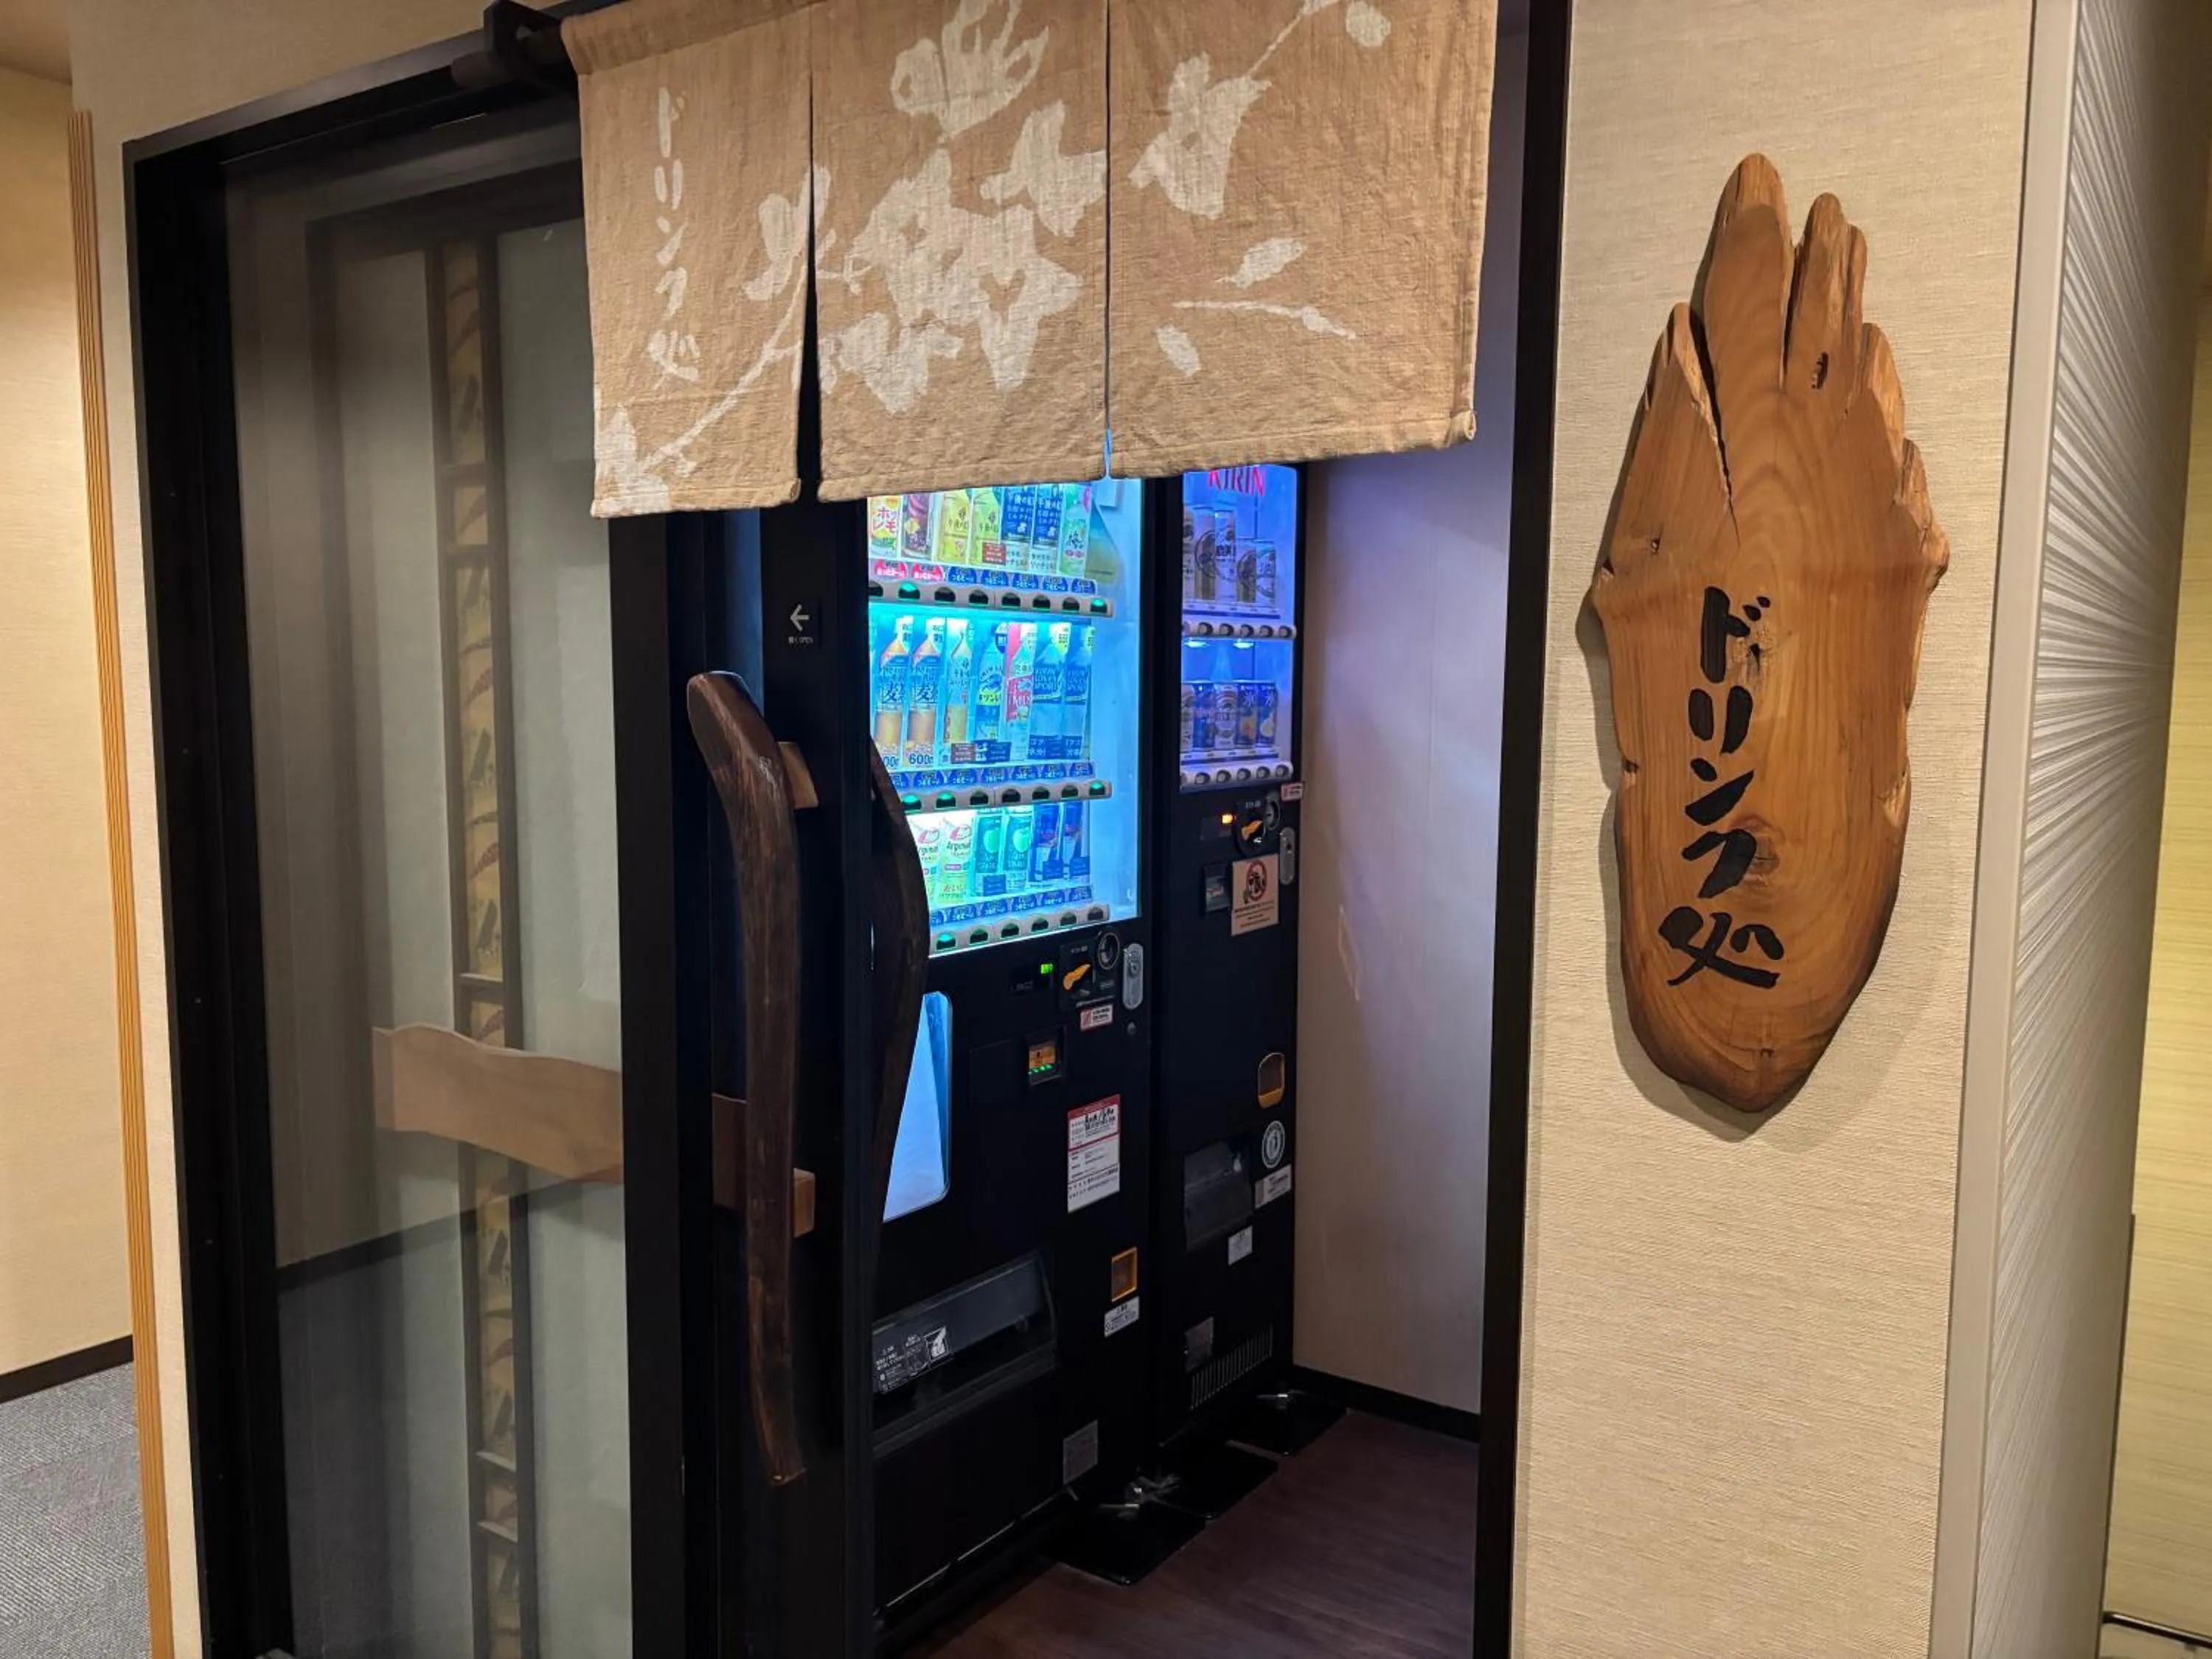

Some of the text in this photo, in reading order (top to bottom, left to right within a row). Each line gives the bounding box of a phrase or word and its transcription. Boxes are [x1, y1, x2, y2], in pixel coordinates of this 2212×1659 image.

[647, 86, 700, 390] ドリンク処
[1208, 467, 1266, 495] KIRIN
[1658, 586, 1784, 989] ドリンク処
